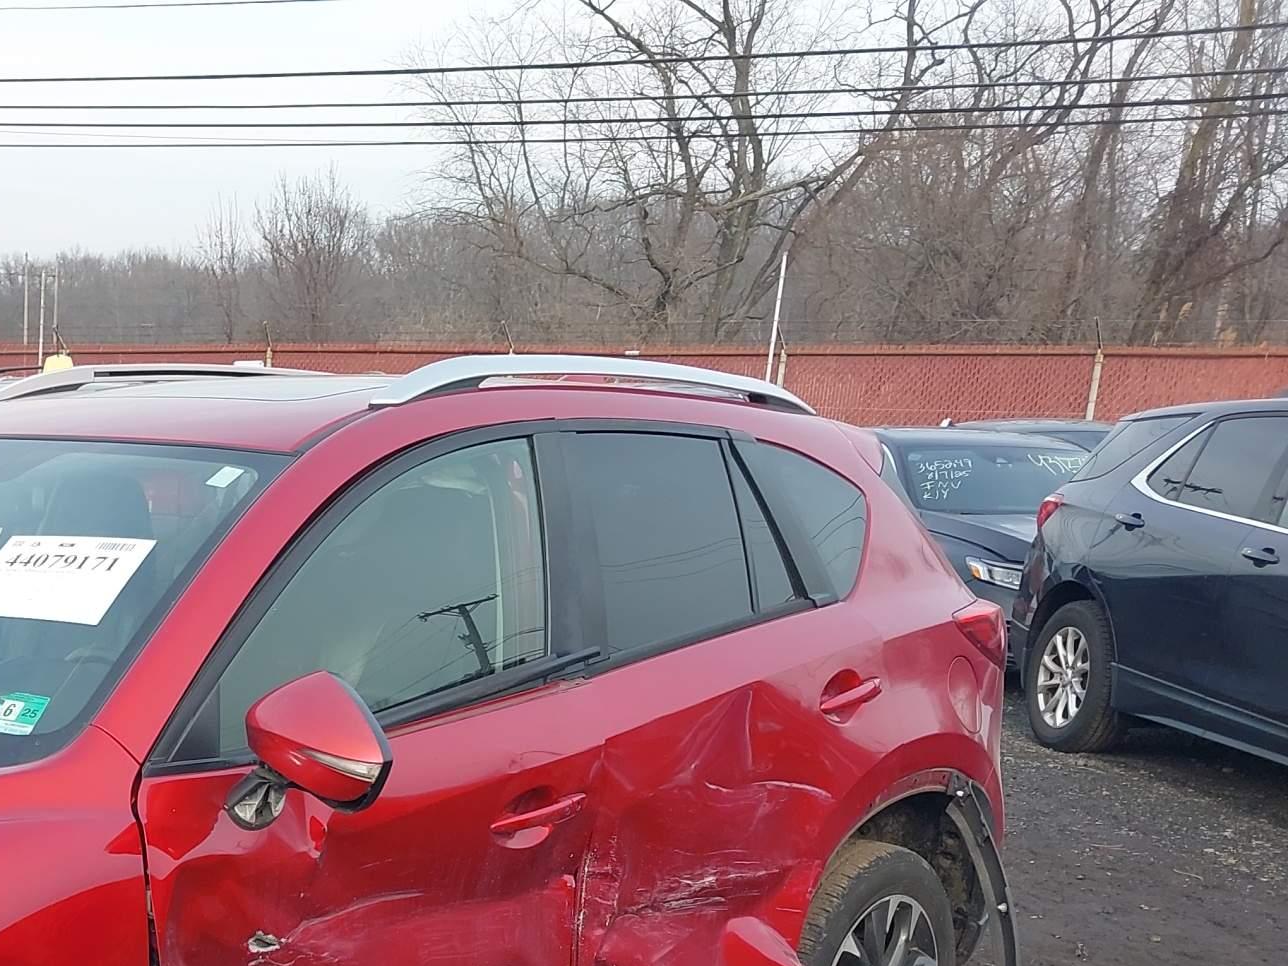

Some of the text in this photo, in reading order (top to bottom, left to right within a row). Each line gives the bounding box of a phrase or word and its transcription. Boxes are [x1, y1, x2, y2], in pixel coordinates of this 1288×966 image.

[5, 553, 120, 572] 44079171
[2, 703, 17, 718] 6
[21, 708, 40, 719] 25
